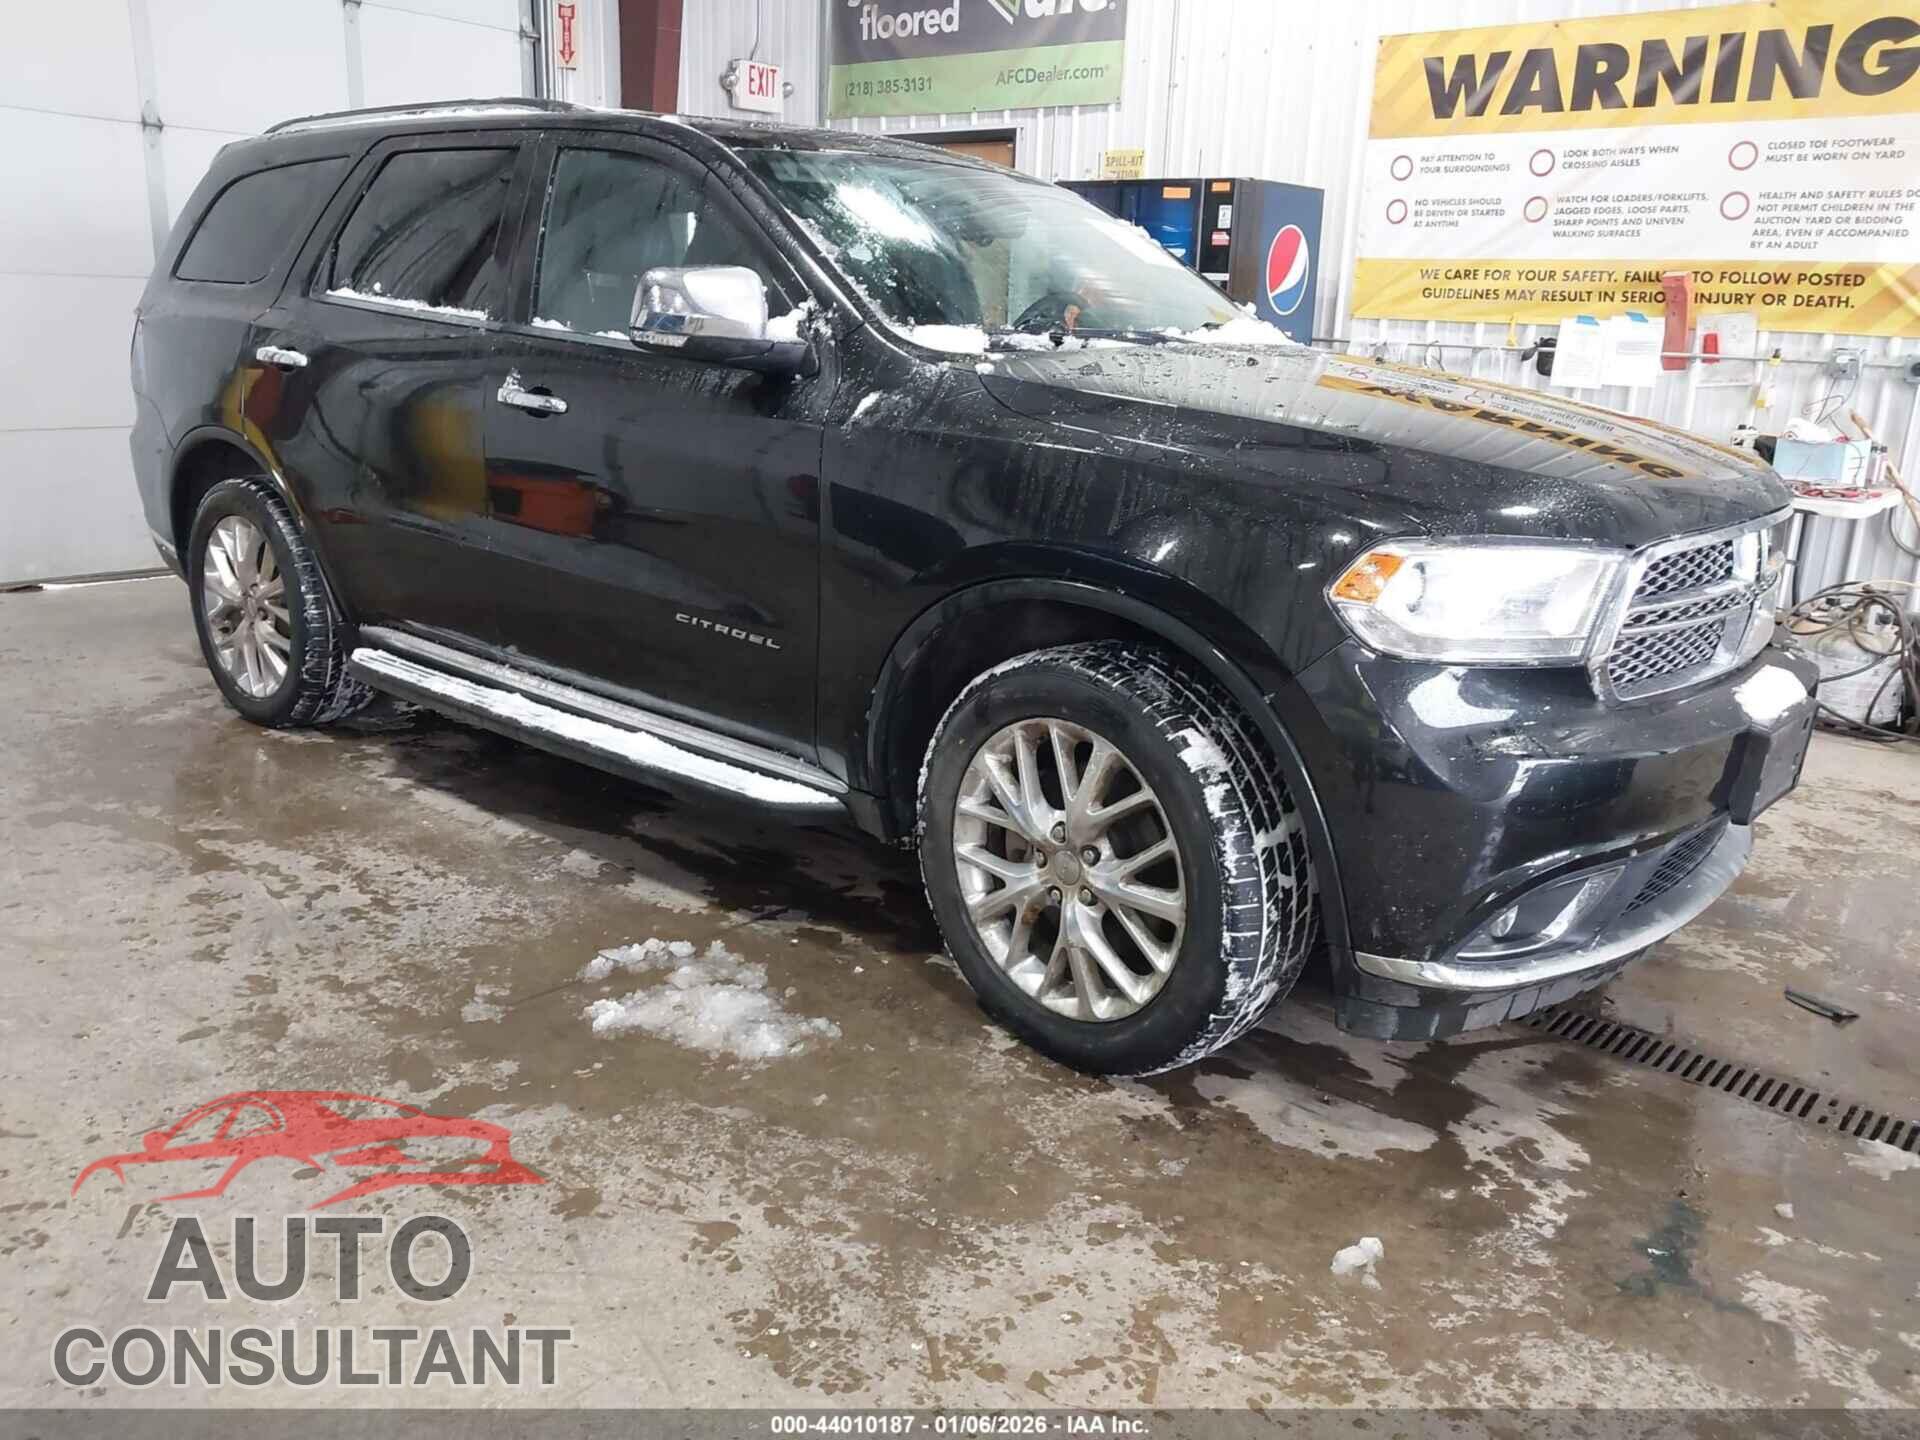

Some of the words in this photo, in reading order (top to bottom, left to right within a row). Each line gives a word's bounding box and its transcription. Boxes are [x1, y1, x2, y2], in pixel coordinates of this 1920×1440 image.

[860, 0, 960, 41] floored
[1422, 16, 1920, 120] WARNING
[749, 65, 777, 98] EXIT
[845, 81, 873, 98] (218)
[877, 76, 933, 95] 385-3131
[1767, 140, 1806, 150] CLOSED
[1809, 139, 1828, 149] TOE
[1831, 137, 1896, 148] FOOTWEAR
[1563, 149, 1589, 159] LOOK
[1592, 148, 1617, 157] BOTH
[1619, 146, 1645, 156] WAYS
[1649, 145, 1680, 154] WHEN
[1765, 153, 1794, 163] MUST
[1797, 153, 1809, 162] BE
[1812, 151, 1848, 161] WORN
[1851, 151, 1871, 161] ON
[1874, 150, 1905, 160] YARD
[1436, 153, 1481, 162] ATTENTION
[1484, 153, 1496, 161] TO
[1562, 160, 1608, 170] CROSSING
[1610, 158, 1641, 168] AISLES
[1420, 166, 1441, 174] YOUR
[1557, 195, 1588, 204] WATCH
[1591, 195, 1609, 203] FOR
[1758, 192, 1797, 200] HEALTH
[1800, 191, 1824, 200] AND
[1827, 190, 1866, 199] SAFETY
[1868, 190, 1903, 199] RULES
[1415, 199, 1429, 207] NO
[1468, 198, 1502, 206] SHOULD
[1756, 204, 1779, 213] NOT
[1781, 203, 1818, 212] PERMIT
[1820, 203, 1874, 212] CHILDREN
[1877, 203, 1890, 211] IN
[1894, 202, 1915, 211] THE
[1471, 208, 1506, 217] STARTED
[1554, 207, 1591, 216] JAGGED
[1627, 206, 1657, 215] LOOSE
[1554, 218, 1583, 227] SHARP
[1586, 218, 1619, 227] POINTS
[1622, 217, 1643, 226] AND
[1645, 217, 1685, 226] UNEVEN
[1754, 216, 1801, 225] AUCTION
[1805, 216, 1832, 225] YARD
[1835, 216, 1851, 225] OR
[1854, 216, 1904, 225] BIDDING
[1552, 230, 1595, 239] WALKING
[1597, 229, 1641, 238] SURFACES
[1785, 229, 1812, 237] EVEN
[1815, 229, 1825, 237] IF
[1827, 228, 1910, 238] ACCOMPANIED
[1750, 241, 1763, 249] BY
[1766, 241, 1782, 249] AN
[1785, 241, 1818, 250] ADULT
[1420, 269, 1440, 280] WE
[1444, 269, 1479, 281] CARE
[1484, 269, 1511, 281] FOR
[1517, 270, 1556, 282] YOUR
[1562, 270, 1618, 283] SAFETY.
[1692, 271, 1713, 284] TO
[1719, 272, 1791, 286] FOLLOW
[1797, 273, 1866, 287] POSTED
[1422, 287, 1500, 300] GUIDELINES
[1504, 289, 1537, 301] MAY
[1541, 290, 1592, 302] RESULT
[1598, 291, 1615, 303] IN
[1621, 291, 1667, 304] SERIO
[1694, 292, 1756, 305] INJURY
[1761, 293, 1786, 306] OR
[1792, 294, 1856, 309] DEATH.
[675, 612, 781, 649] CITADEL
